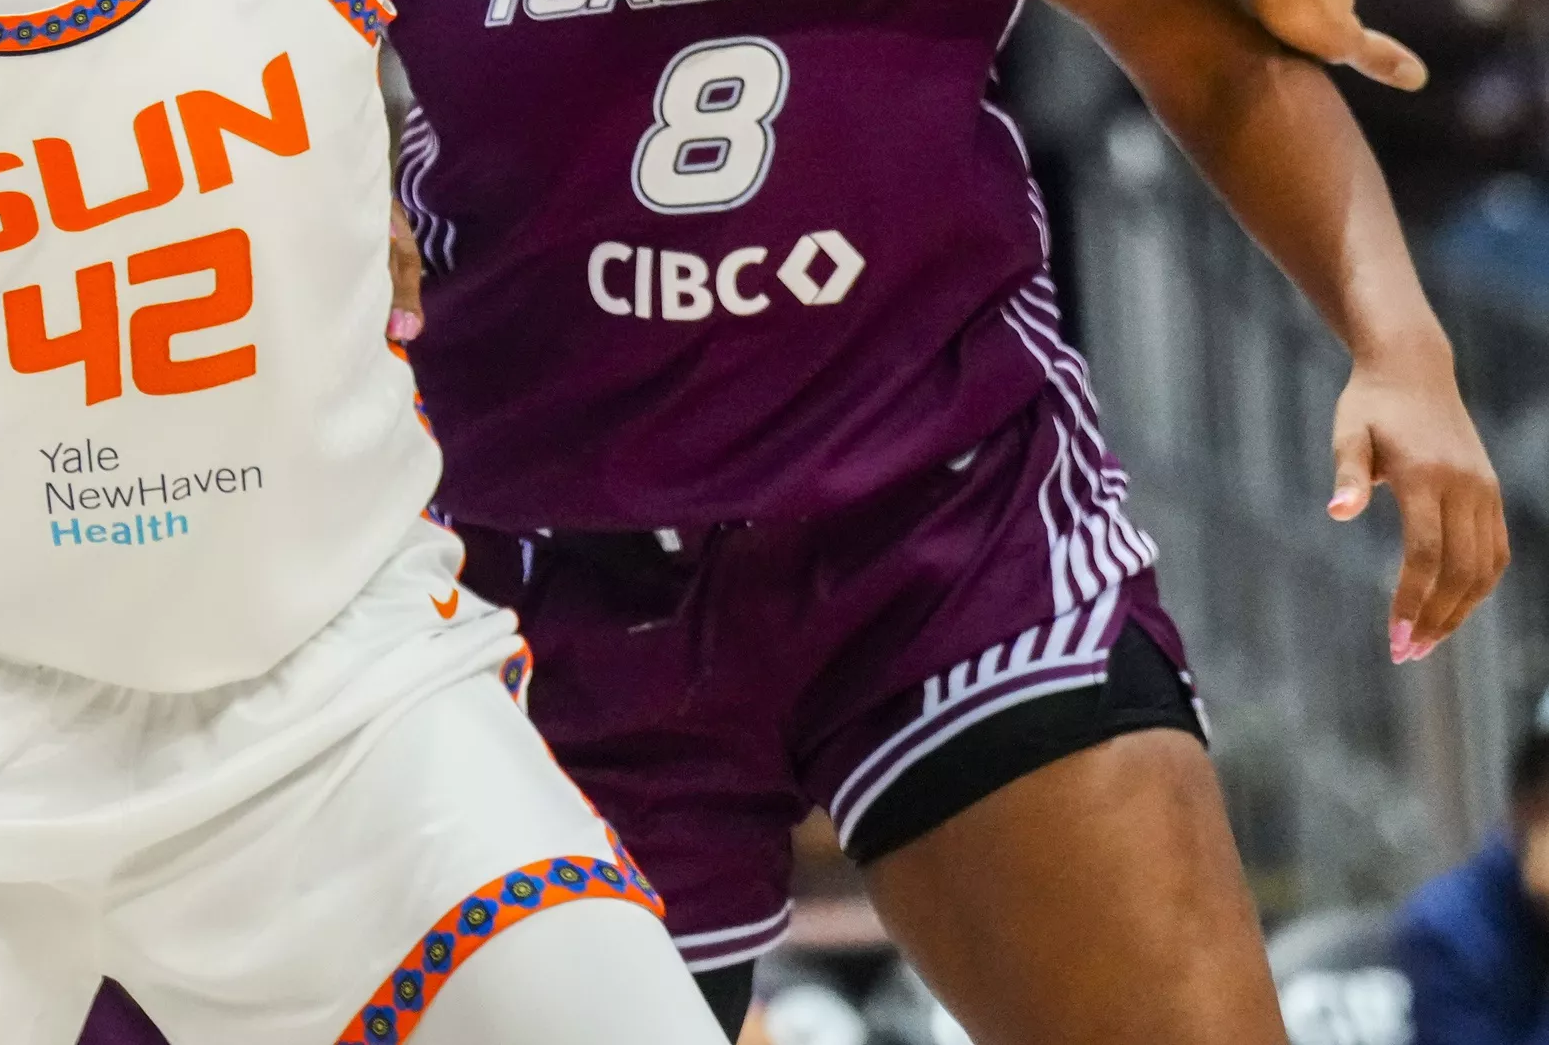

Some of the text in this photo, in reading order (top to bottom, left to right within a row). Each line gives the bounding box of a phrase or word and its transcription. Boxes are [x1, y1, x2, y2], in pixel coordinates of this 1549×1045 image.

[631, 35, 791, 215] 8
[587, 241, 772, 321] CIBC
[2, 227, 257, 407] 42
[39, 438, 120, 474] Yale
[45, 465, 263, 515] NewHaven
[50, 510, 189, 546] Health
